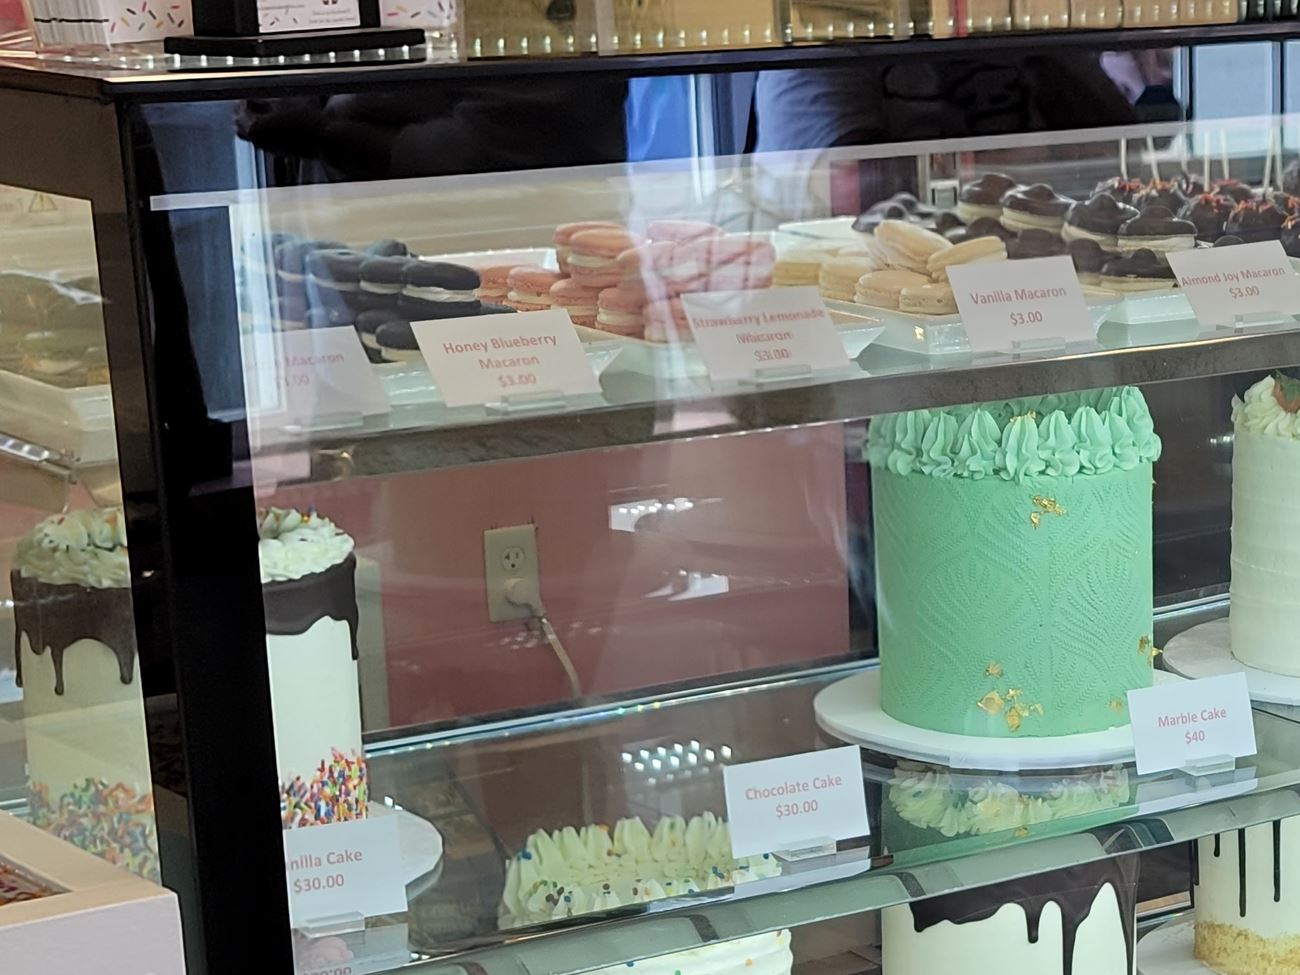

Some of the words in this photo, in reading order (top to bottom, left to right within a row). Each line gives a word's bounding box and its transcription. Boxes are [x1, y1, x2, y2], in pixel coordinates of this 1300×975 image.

[1181, 273, 1221, 287] Almond
[1223, 271, 1240, 283] Joy
[1241, 267, 1286, 280] Macaron
[969, 290, 1013, 305] Vanilla
[1014, 286, 1067, 301] Macaron
[1229, 285, 1260, 299] $3.00
[1010, 311, 1043, 326] $3.00
[443, 341, 488, 354] Honey
[490, 335, 557, 350] Blueberry
[478, 355, 540, 370] Macaron
[1158, 712, 1198, 727] Marble
[1201, 707, 1227, 721] Cake
[1185, 730, 1205, 744] $40
[745, 781, 809, 800] Chocolate
[813, 774, 842, 790] Cake
[776, 800, 818, 818] $30.00
[287, 854, 322, 871] nilla
[327, 850, 364, 865] Cake
[293, 873, 345, 893] $30.00
